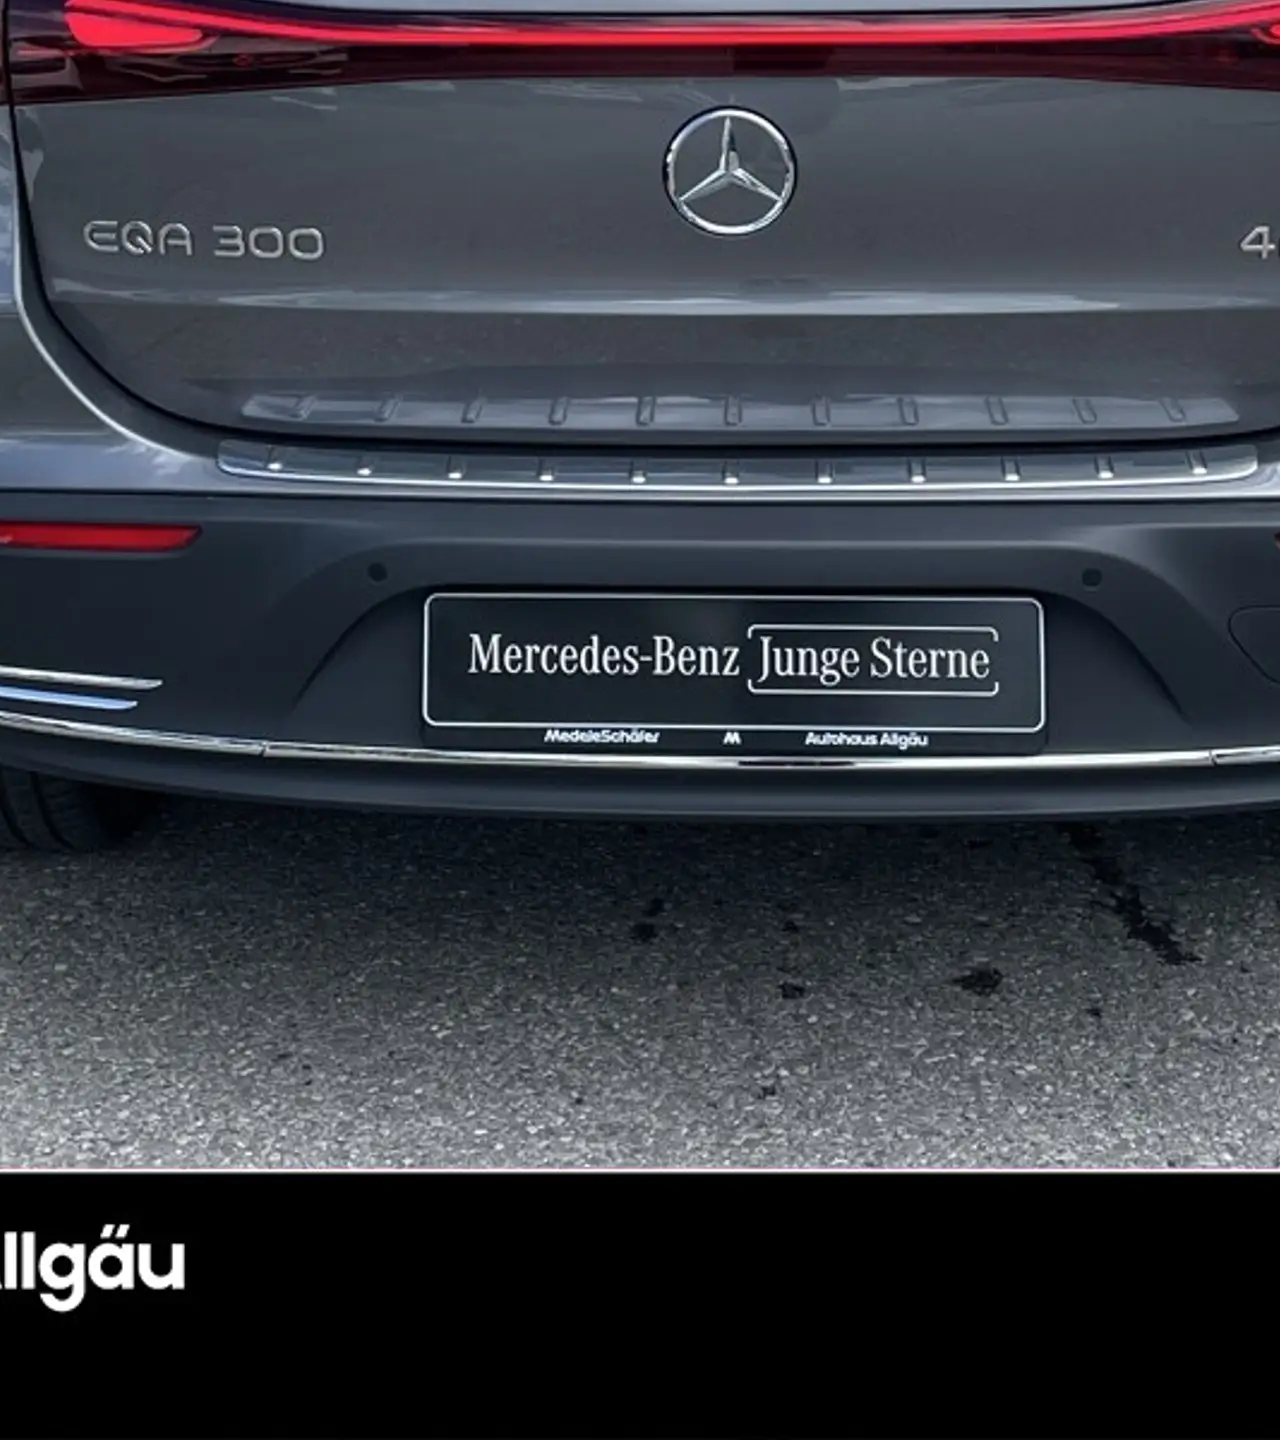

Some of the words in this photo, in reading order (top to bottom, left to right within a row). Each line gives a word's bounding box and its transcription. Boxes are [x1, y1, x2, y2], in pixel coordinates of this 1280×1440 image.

[82, 219, 194, 256] EQA
[211, 224, 325, 261] 300
[467, 632, 741, 677] Mercedes-Benz
[756, 636, 860, 686] Junge
[869, 636, 991, 680] Sterne
[542, 729, 661, 744] MedeleSchäfer
[804, 731, 879, 746] Autohaus
[880, 731, 929, 751] Allgäu
